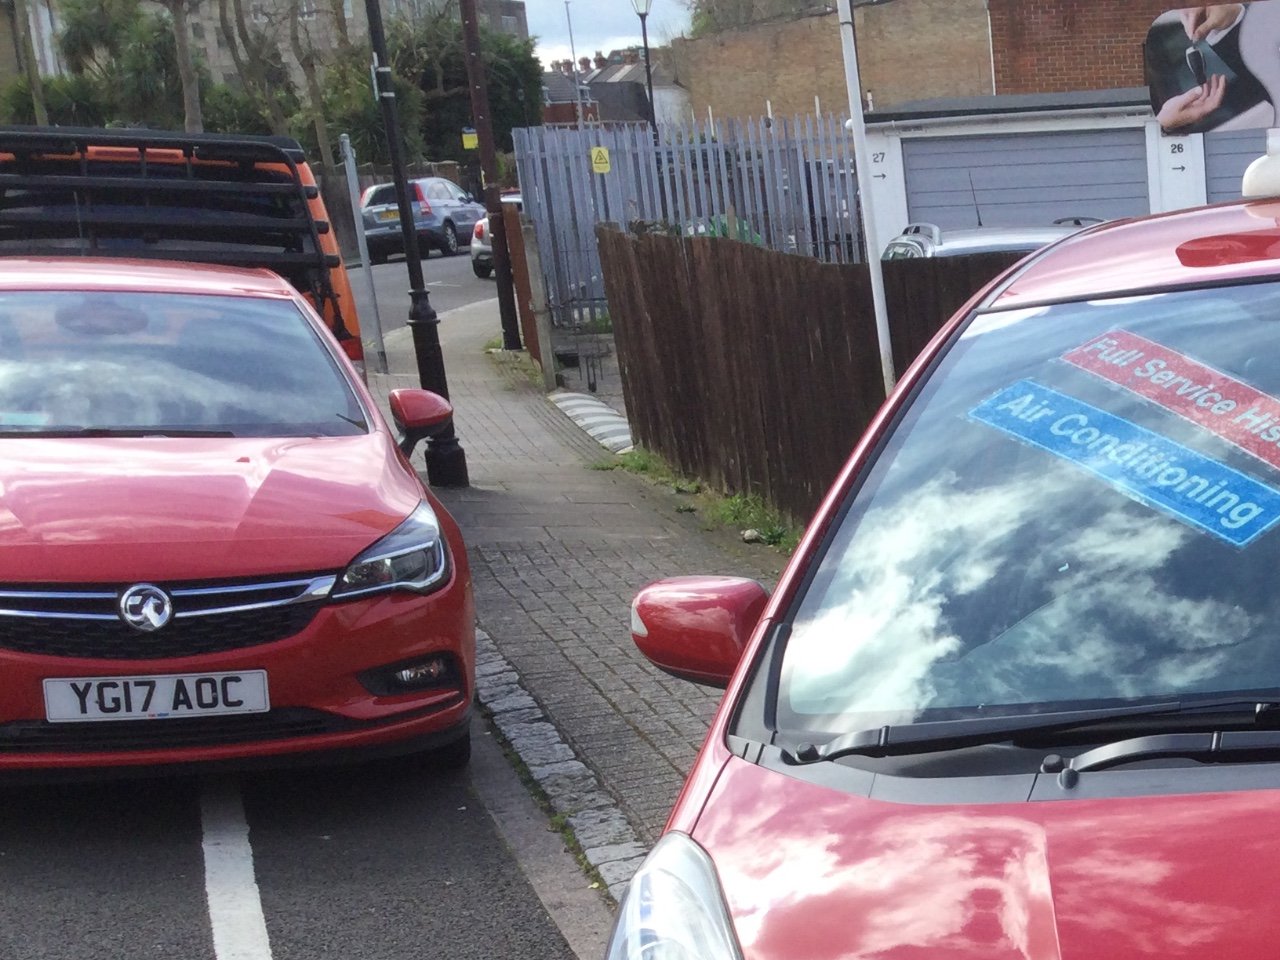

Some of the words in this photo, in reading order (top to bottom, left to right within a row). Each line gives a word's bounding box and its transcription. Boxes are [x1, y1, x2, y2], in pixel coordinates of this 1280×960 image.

[872, 152, 886, 163] 27
[1170, 143, 1184, 154] 26
[1084, 337, 1139, 368] Full
[1135, 358, 1237, 414] Service
[999, 393, 1053, 424] Air
[1049, 413, 1265, 530] Conditioning
[69, 678, 157, 715] YG17
[171, 676, 244, 711] AOC
